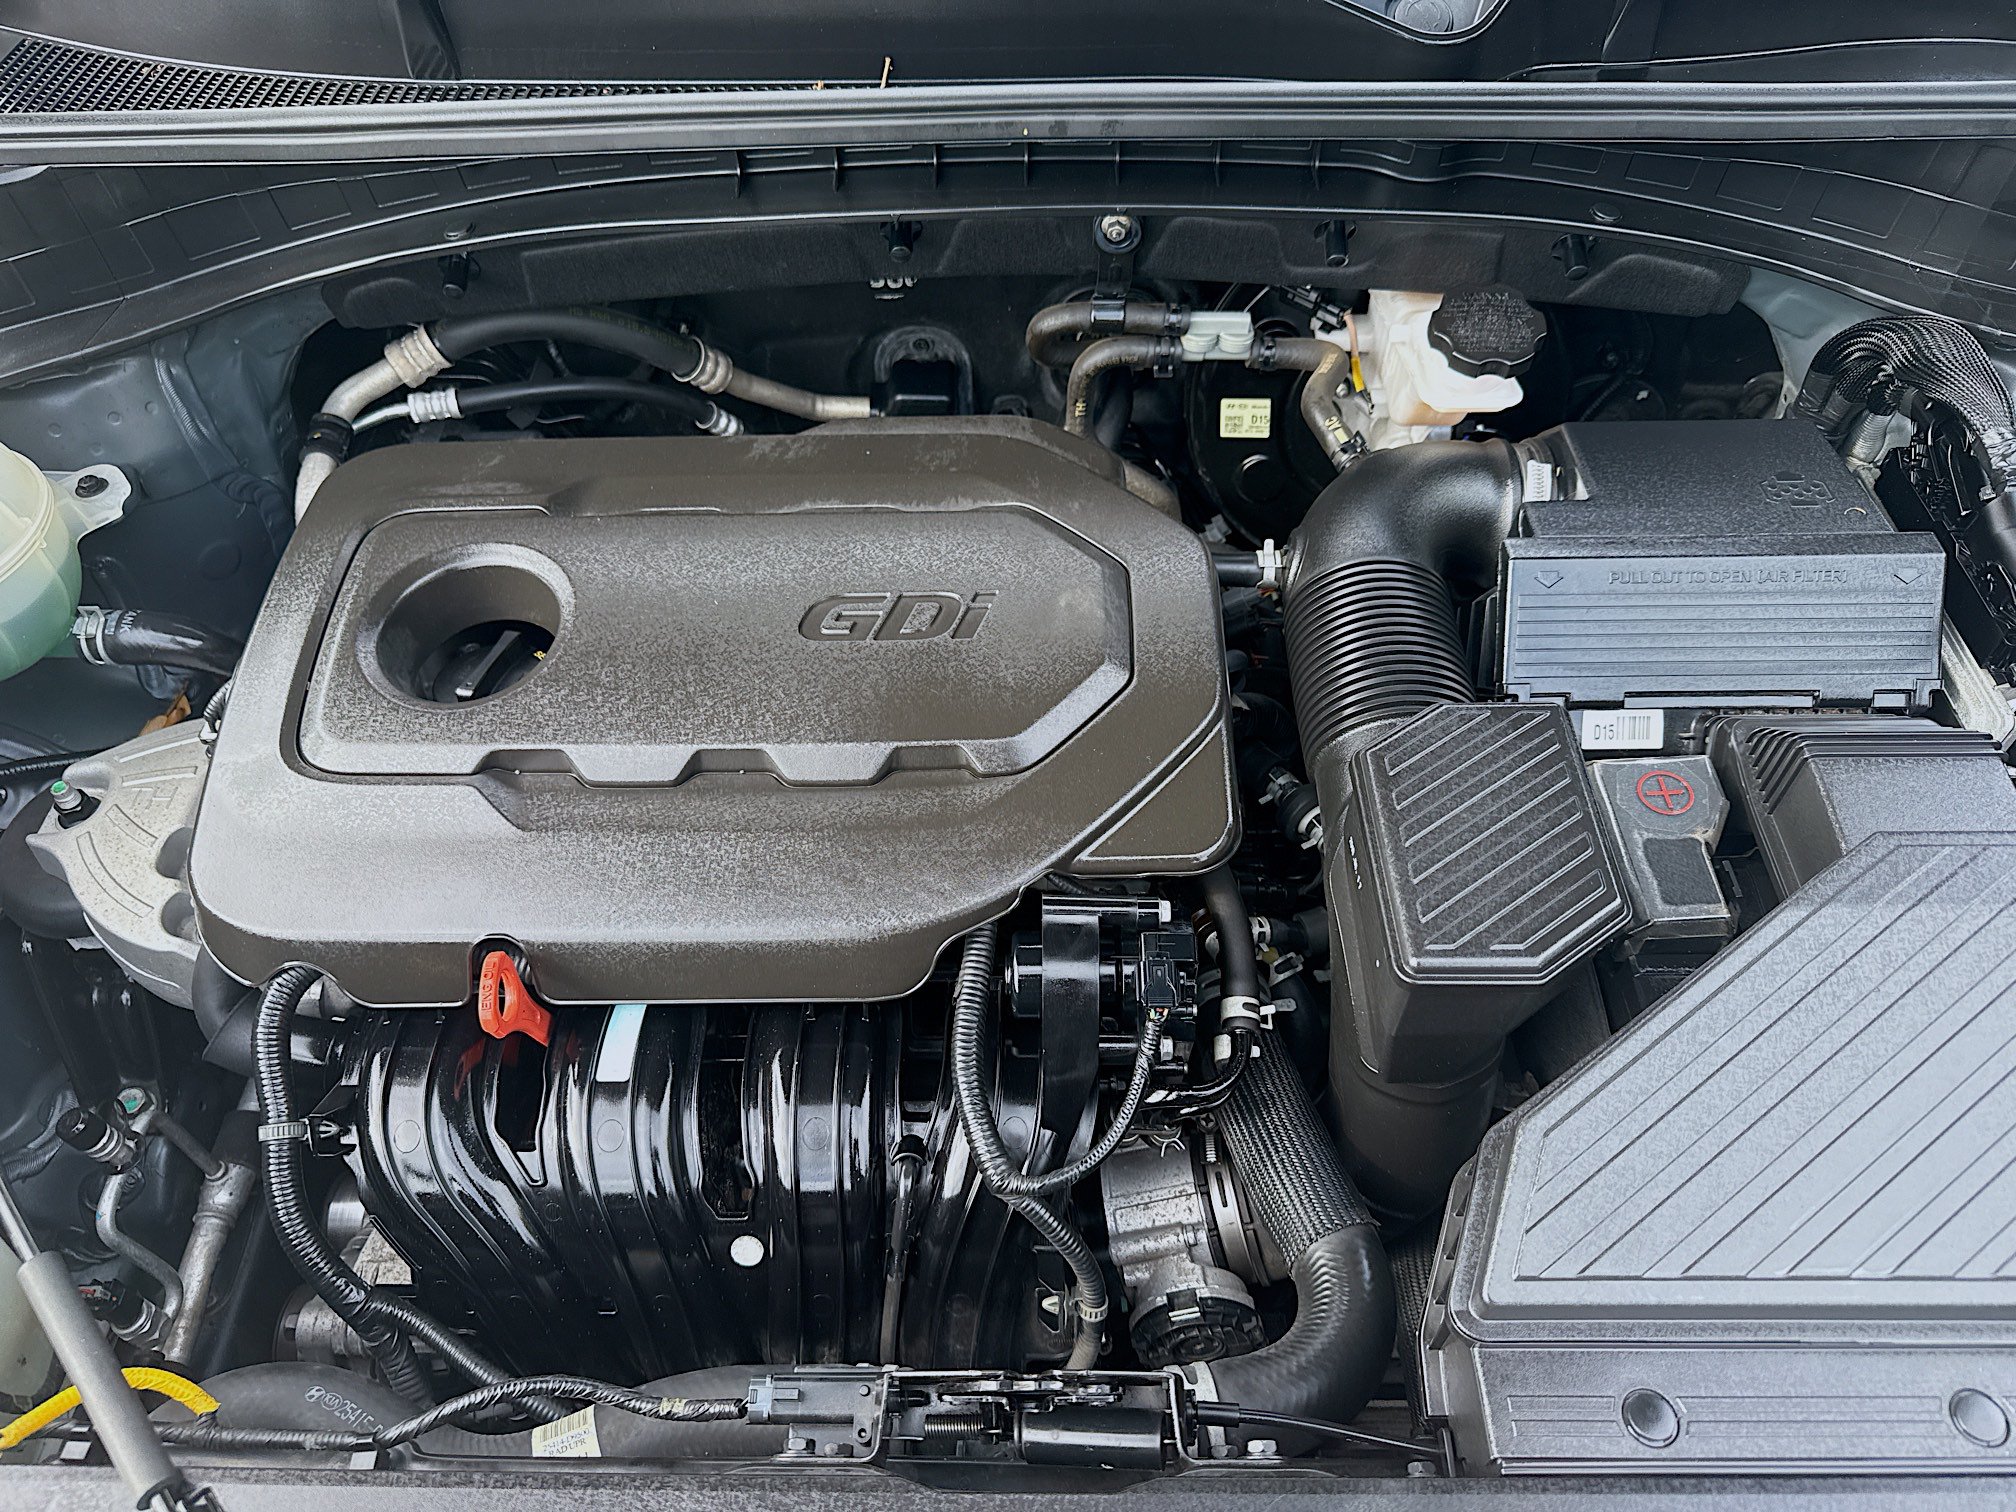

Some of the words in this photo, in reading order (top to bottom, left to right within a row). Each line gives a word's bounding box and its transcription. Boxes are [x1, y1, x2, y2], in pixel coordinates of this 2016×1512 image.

[1608, 571, 1648, 584] PULL
[1651, 571, 1682, 584] OUT
[1685, 571, 1706, 584] TO
[1709, 571, 1751, 583] OPEN
[119, 609, 142, 634] ANK
[798, 589, 999, 641] GDi
[1593, 724, 1615, 741] D15
[483, 960, 497, 980] OIL
[481, 983, 493, 1011] ENG
[321, 1393, 342, 1409] KIA
[568, 1437, 586, 1450] UPR
